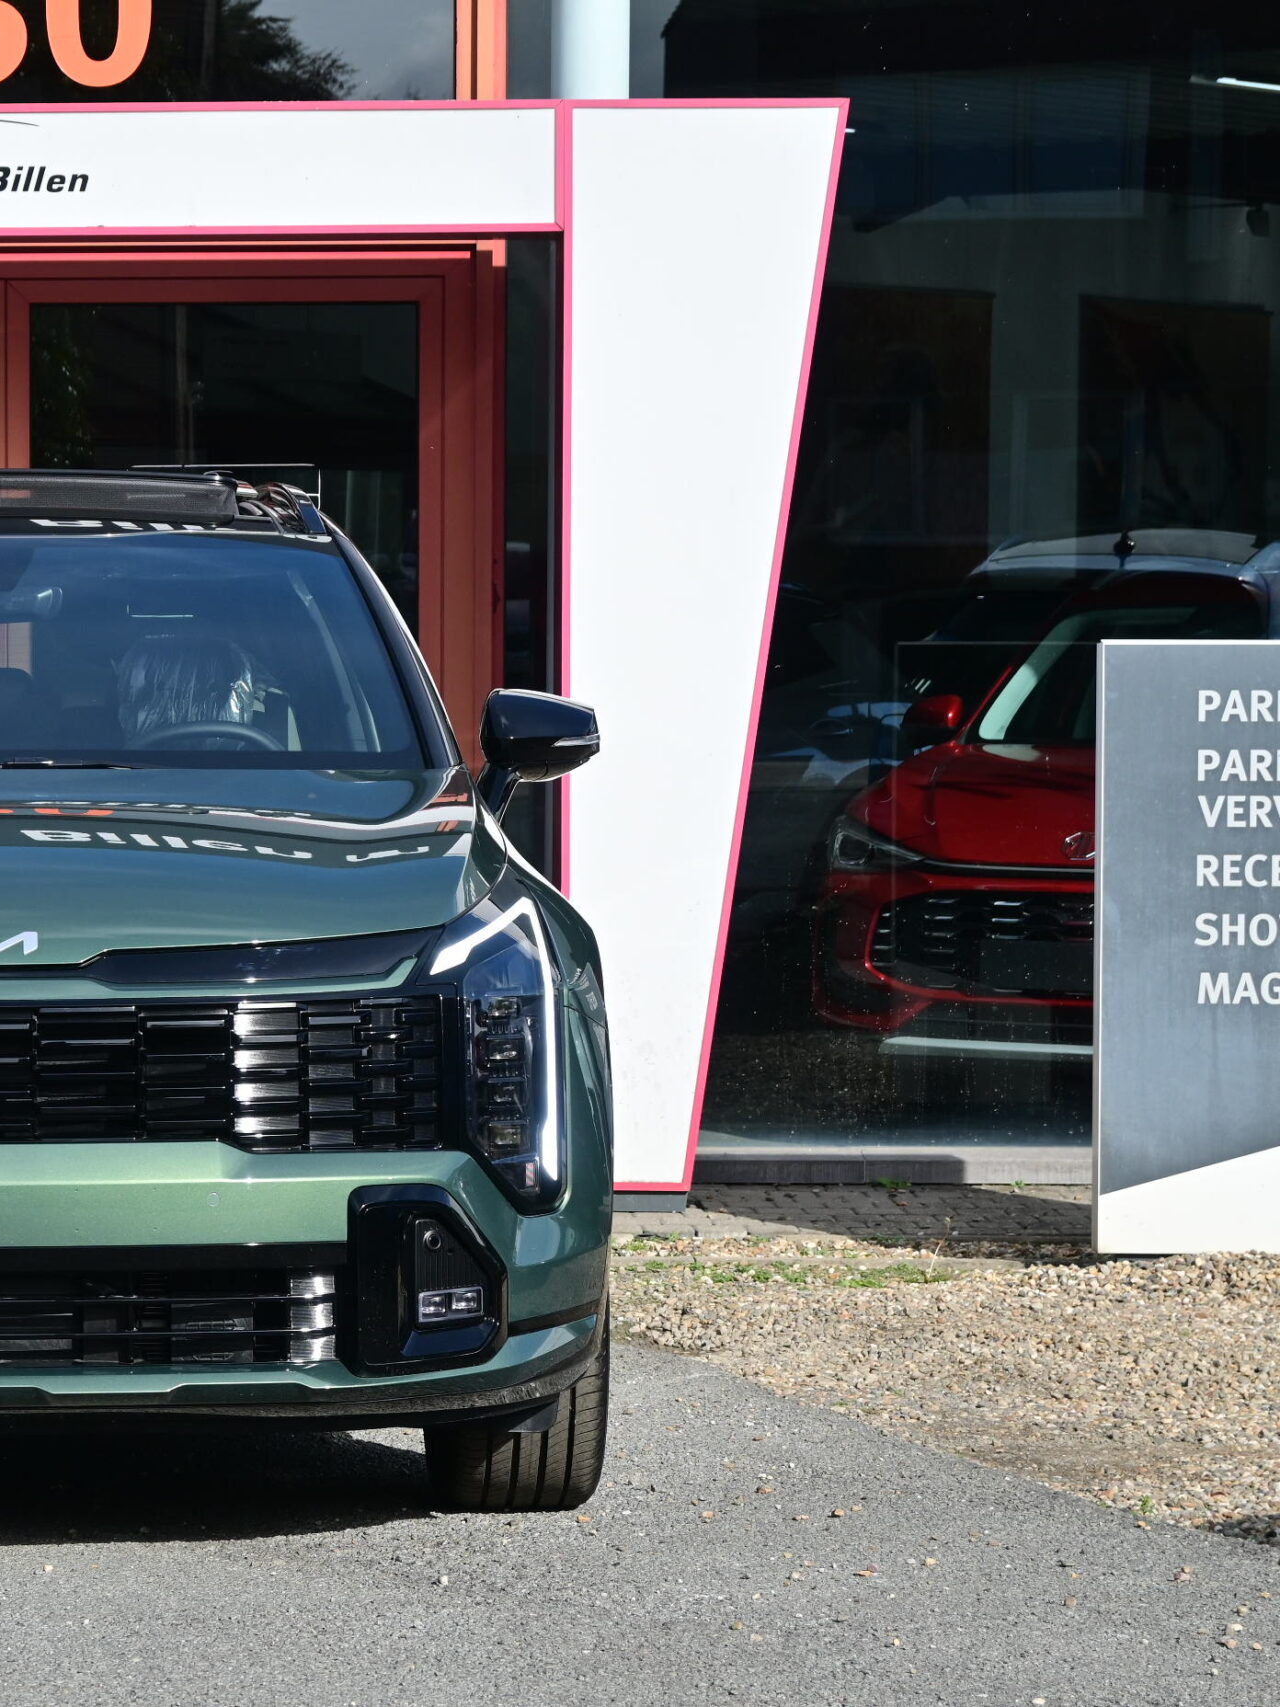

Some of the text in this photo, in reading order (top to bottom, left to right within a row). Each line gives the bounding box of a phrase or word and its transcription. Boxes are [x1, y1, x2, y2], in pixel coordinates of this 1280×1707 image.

[1198, 689, 1280, 722] PAR
[1197, 749, 1280, 782] PAR
[1194, 912, 1280, 947] SHO
